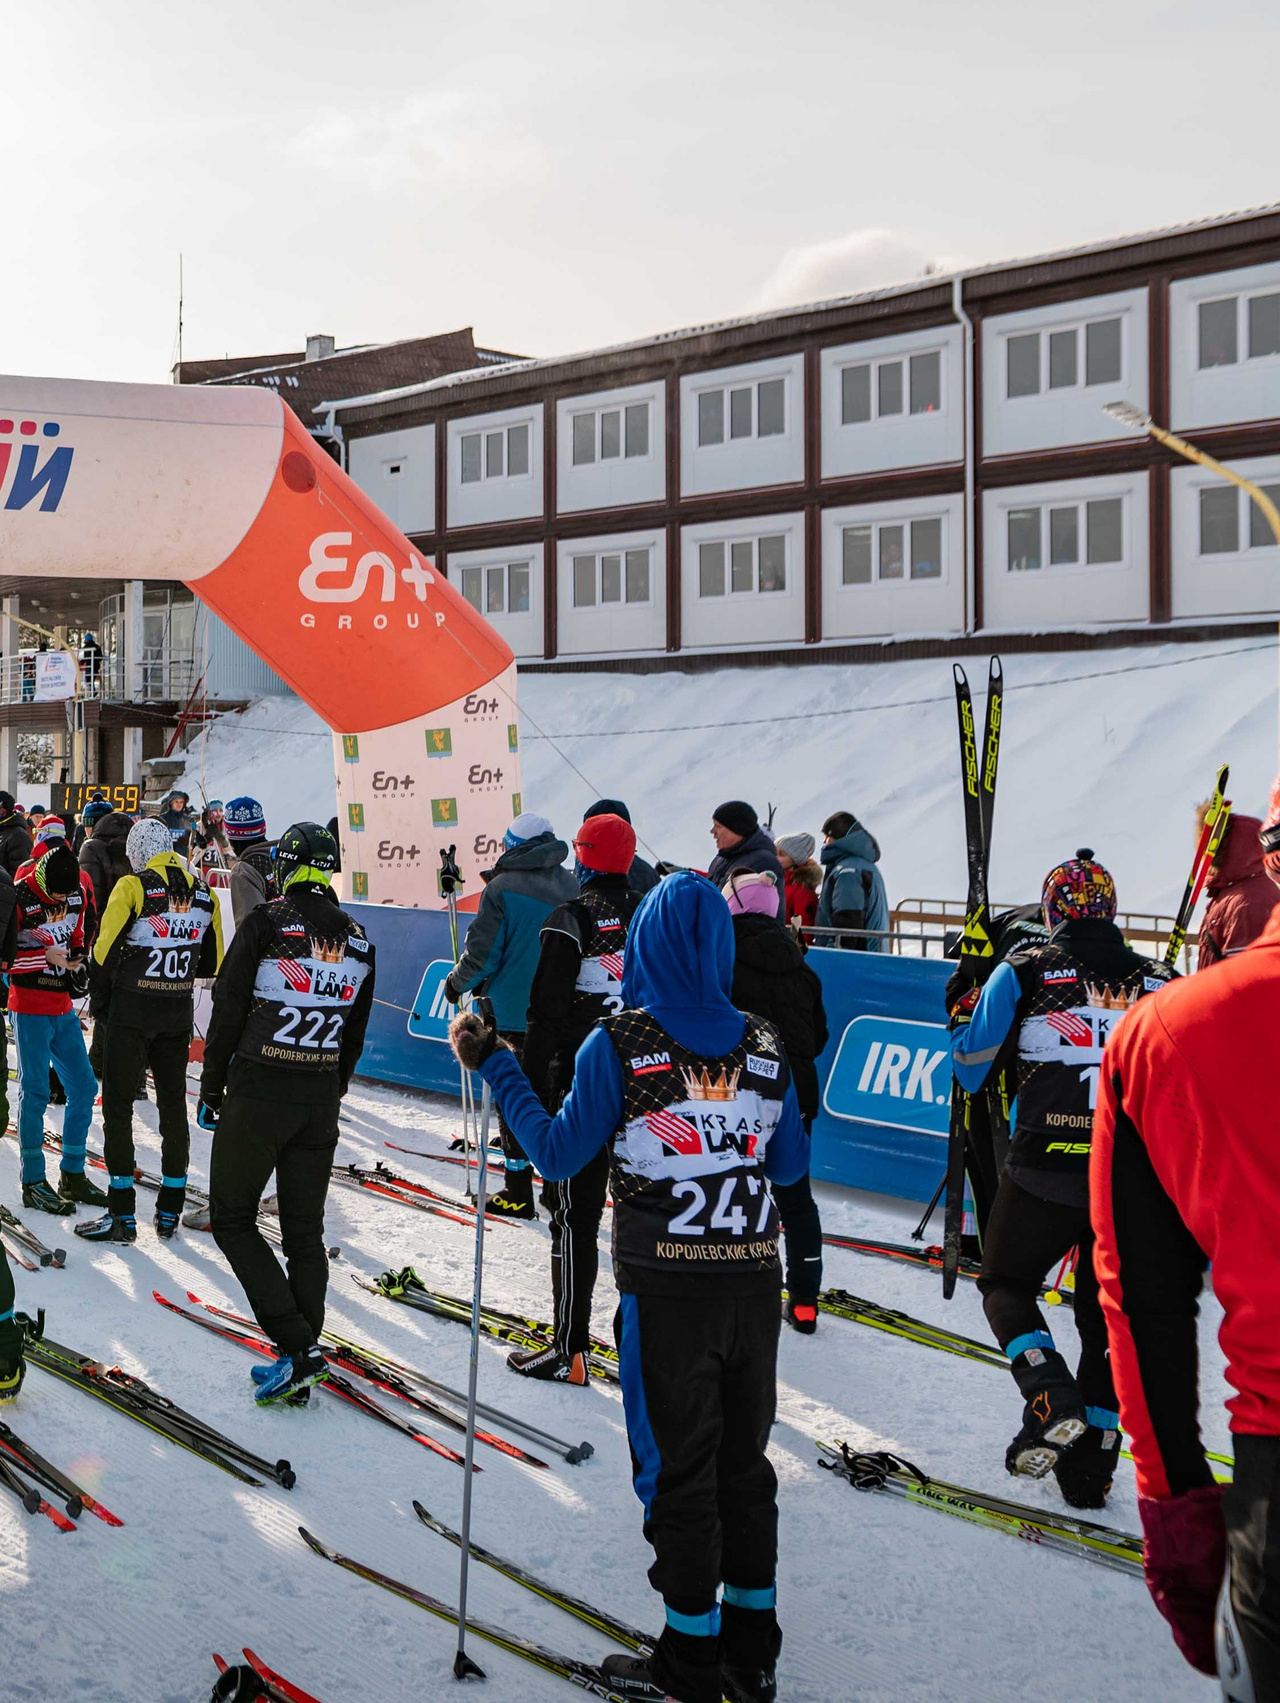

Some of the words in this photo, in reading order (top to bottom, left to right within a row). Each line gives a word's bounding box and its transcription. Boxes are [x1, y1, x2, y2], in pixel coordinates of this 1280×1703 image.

[299, 612, 447, 630] GROUP
[960, 699, 979, 798] FISCHER
[984, 694, 1003, 793] FISCHER
[279, 851, 298, 860] LEKI
[147, 887, 166, 897] БАМ
[171, 918, 202, 928] KRAS
[597, 917, 622, 928] БАМ
[170, 927, 199, 940] LAND
[145, 949, 193, 979] 203
[316, 969, 358, 987] KRAS
[1043, 969, 1077, 980] БАМ
[313, 980, 354, 1000] LAND
[602, 996, 624, 1016] 3
[273, 1006, 344, 1048] 222
[631, 1052, 670, 1069] БАМ
[857, 1040, 950, 1105] IRK.
[1079, 1066, 1100, 1110] 1
[700, 1114, 762, 1134] KRAS
[1046, 1113, 1095, 1129] КОРОЛЕ
[667, 1175, 771, 1236] 247
[656, 1241, 747, 1261] КОРОЛЕВСКИЕ
